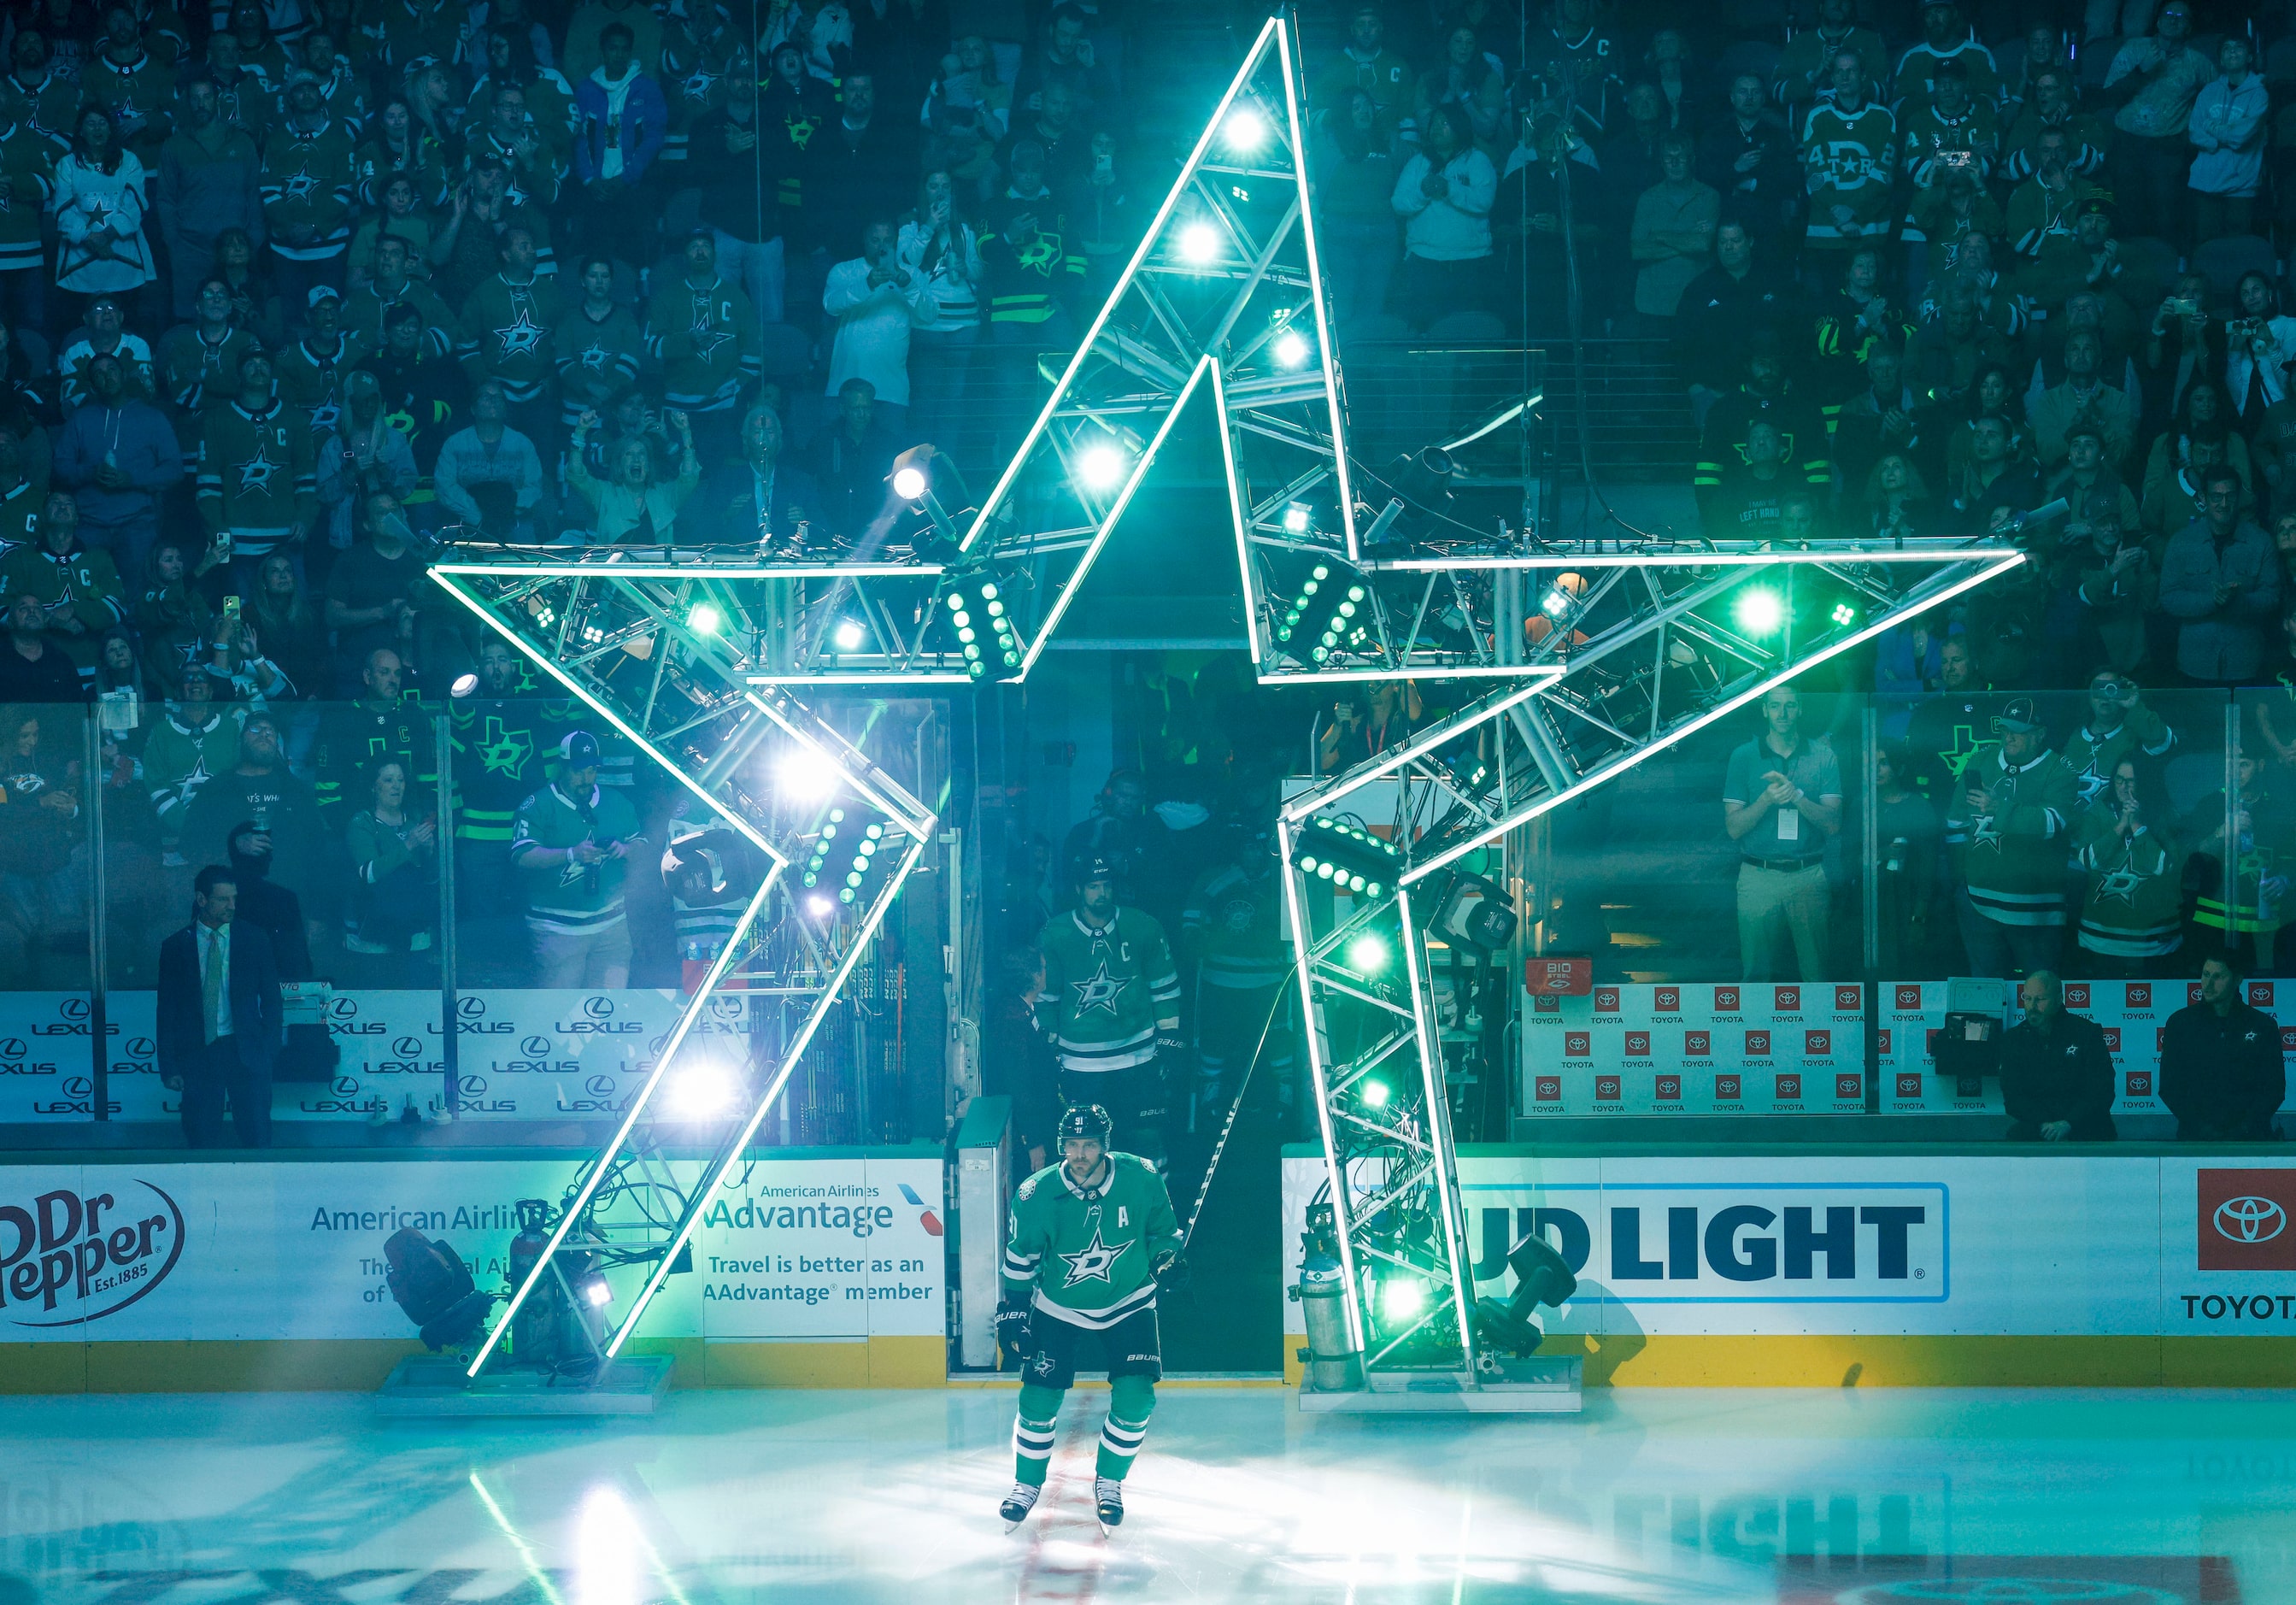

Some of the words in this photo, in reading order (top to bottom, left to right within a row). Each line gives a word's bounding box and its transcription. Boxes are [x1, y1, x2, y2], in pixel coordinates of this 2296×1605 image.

[1598, 39, 1609, 56] C
[1390, 68, 1401, 83] C
[722, 302, 731, 321] C
[277, 428, 286, 446] C
[26, 514, 37, 532] C
[80, 568, 91, 587] C
[1120, 941, 1131, 962] C
[1547, 962, 1571, 973] BIO
[329, 1023, 386, 1034] XUS
[555, 1022, 643, 1033] LEXUS
[0, 1063, 56, 1074] XUS
[492, 1061, 579, 1073] LEXUS
[301, 1101, 388, 1112] LEXUS
[557, 1101, 626, 1112] LEXU
[1075, 1116, 1083, 1126] 91
[760, 1185, 825, 1197] American
[827, 1185, 880, 1197] Airlines
[35, 1190, 114, 1255] Dr
[311, 1206, 447, 1231] American
[1118, 1205, 1130, 1229] A
[709, 1255, 770, 1273] Travel
[777, 1255, 793, 1273] is
[800, 1255, 866, 1273] better
[871, 1259, 893, 1273] as
[899, 1259, 925, 1273] an
[363, 1285, 385, 1302] of
[846, 1283, 933, 1301] member
[2181, 1295, 2296, 1319] TOYOT
[995, 1311, 1027, 1323] AUER
